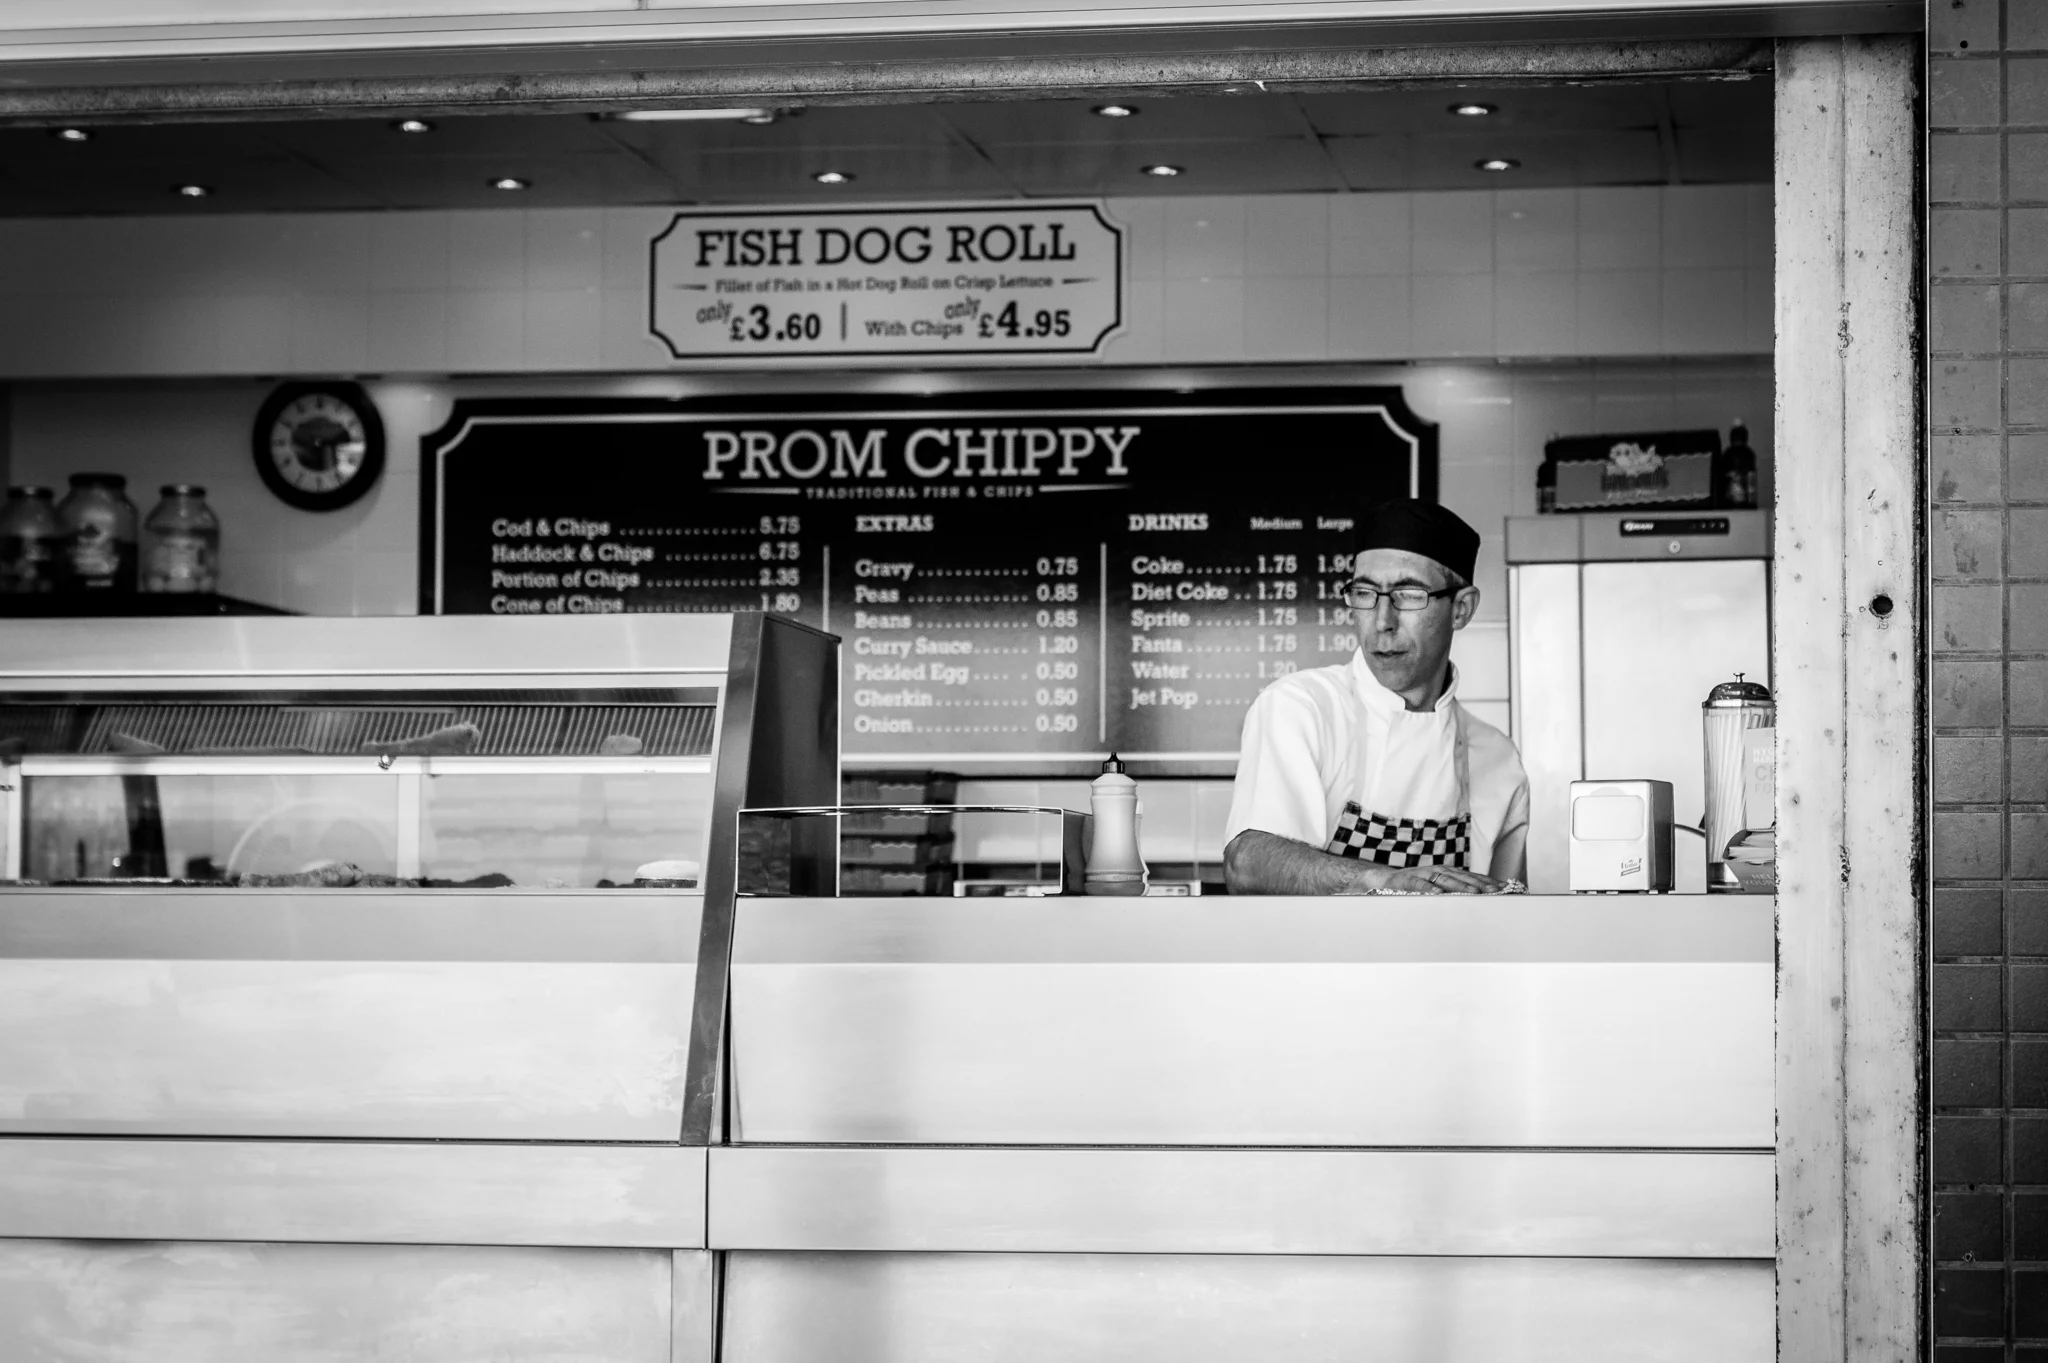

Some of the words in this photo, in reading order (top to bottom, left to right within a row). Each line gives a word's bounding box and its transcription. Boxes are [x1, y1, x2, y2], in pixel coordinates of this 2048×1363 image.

[696, 229, 803, 267] FISH
[815, 226, 933, 264] DOG
[946, 223, 1076, 263] ROLL
[715, 279, 750, 293] Fillet
[756, 279, 769, 292] of
[773, 278, 802, 291] Fish
[807, 280, 820, 291] in
[825, 282, 834, 290] a
[837, 276, 862, 290] Hot
[866, 276, 897, 293] Dog
[901, 275, 929, 289] Roll
[931, 278, 951, 289] on
[954, 274, 997, 292] Crisp
[999, 274, 1053, 288] Lettuce
[696, 300, 733, 325] only
[729, 304, 821, 341] £3.60
[864, 319, 906, 336] With
[910, 318, 964, 339] Chips
[943, 296, 981, 321] only
[977, 300, 1071, 338] £4.95
[703, 429, 888, 480] PROM
[904, 426, 1142, 478] CHIPPY
[806, 485, 917, 499] TRADITIONAL
[922, 485, 960, 499] FISH
[966, 485, 977, 498] &
[983, 485, 1034, 497] CHIPS
[492, 519, 532, 537] Cod
[536, 519, 550, 537] &
[554, 517, 611, 540] Chips
[855, 515, 934, 532] EXTRAS
[1128, 513, 1209, 531] DRINKS
[1250, 517, 1303, 530] Medium
[1316, 516, 1354, 532] Large
[492, 545, 575, 563] Haddock
[579, 545, 594, 562] &
[598, 543, 654, 565] Chips
[759, 542, 801, 561] 6.75
[855, 559, 914, 581] Gravy
[1036, 557, 1079, 576] 0.75
[1131, 556, 1185, 575] Coke
[1257, 554, 1298, 574] 1.75
[492, 570, 559, 588] Portion
[563, 570, 581, 588] of
[584, 569, 640, 591] Chips
[1131, 582, 1173, 600] Diet
[1175, 581, 1229, 600] Coke
[1257, 581, 1298, 600] 1.75
[1317, 580, 1352, 600] 1.9
[492, 595, 541, 612] Cone
[545, 595, 565, 612] of
[568, 594, 624, 613] Chips
[761, 593, 801, 612] 1.80
[855, 585, 900, 602] Peas
[1036, 583, 1079, 602] 0.85
[854, 611, 912, 629] Beans
[1036, 609, 1079, 628] 0.85
[1131, 608, 1191, 631] Sprite
[1257, 607, 1298, 626] 1.75
[854, 636, 912, 658] Curry
[915, 636, 972, 654] Sauce
[1038, 636, 1079, 654] 1.20
[1131, 635, 1184, 653] Fanta
[1257, 633, 1298, 653] 1.75
[1317, 633, 1357, 652] 1.90
[854, 662, 926, 681] Pickled
[930, 662, 969, 684] Egg
[1035, 661, 1079, 680] 0.50
[1131, 661, 1190, 679] Water
[854, 689, 933, 707] Gherkin
[1035, 687, 1079, 706] 0.50
[1160, 687, 1199, 709] Pop
[854, 714, 913, 733] Onion
[1035, 714, 1079, 732] 0.50
